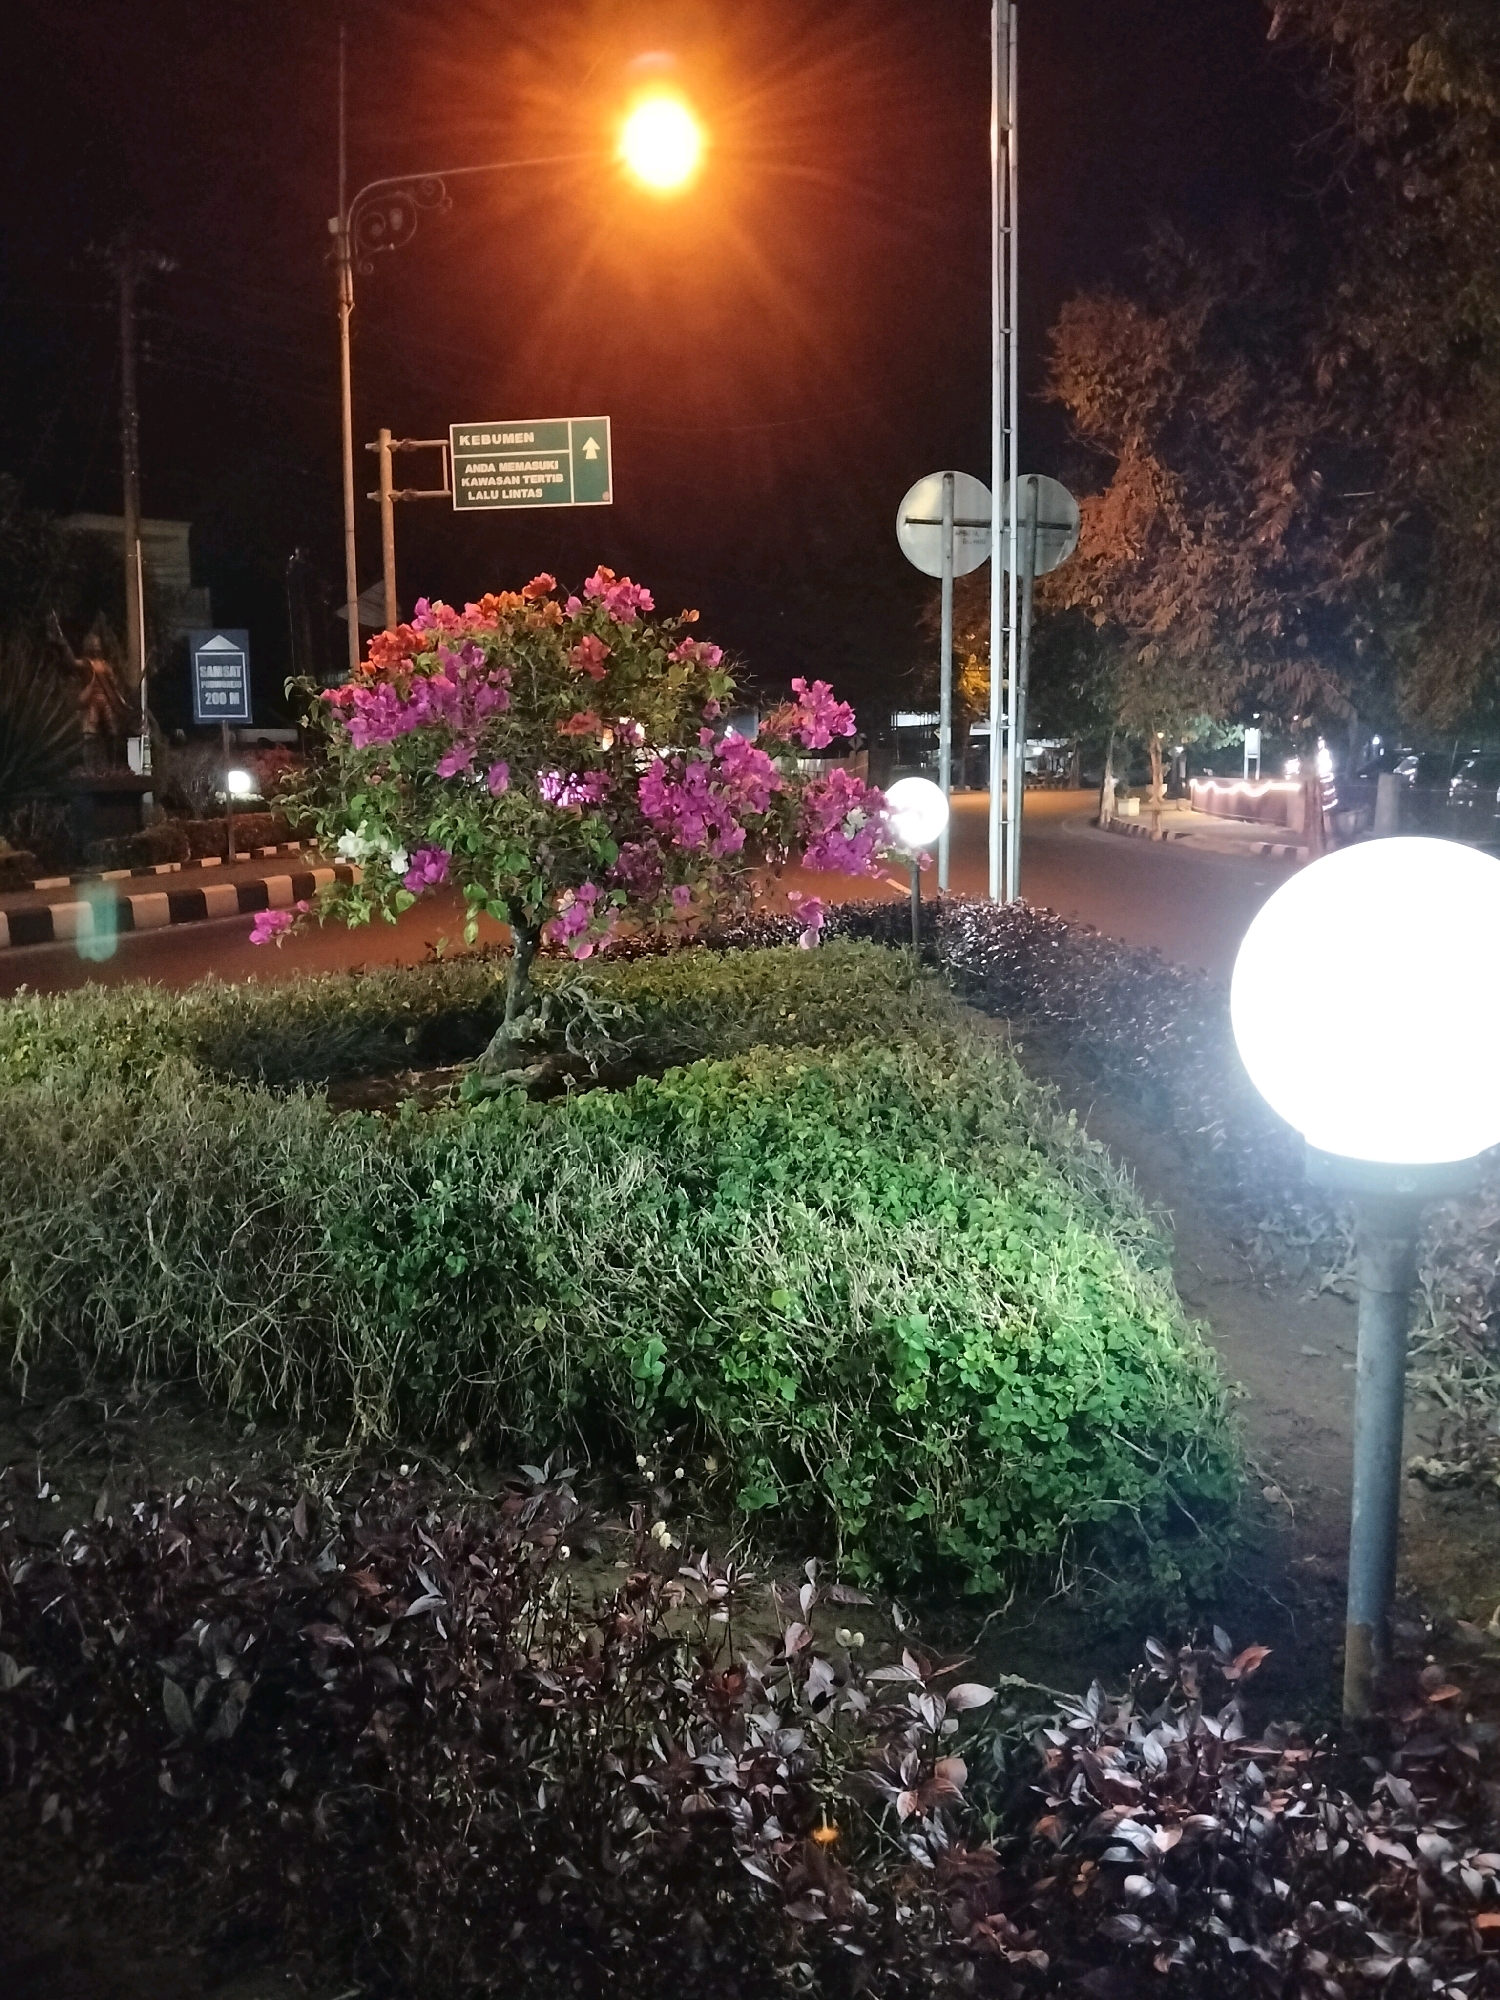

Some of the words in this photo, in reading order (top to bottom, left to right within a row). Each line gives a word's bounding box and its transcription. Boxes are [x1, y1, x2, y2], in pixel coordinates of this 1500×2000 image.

[459, 431, 535, 446] KEBUMEN
[465, 462, 496, 473] ANDA
[498, 460, 559, 472] MEMASUKI
[461, 475, 521, 487] KAWASAN
[523, 473, 564, 484] TERTIB
[468, 489, 499, 501] LALU
[502, 488, 543, 499] LINTAS
[204, 691, 227, 705] 200
[229, 692, 240, 705] M
